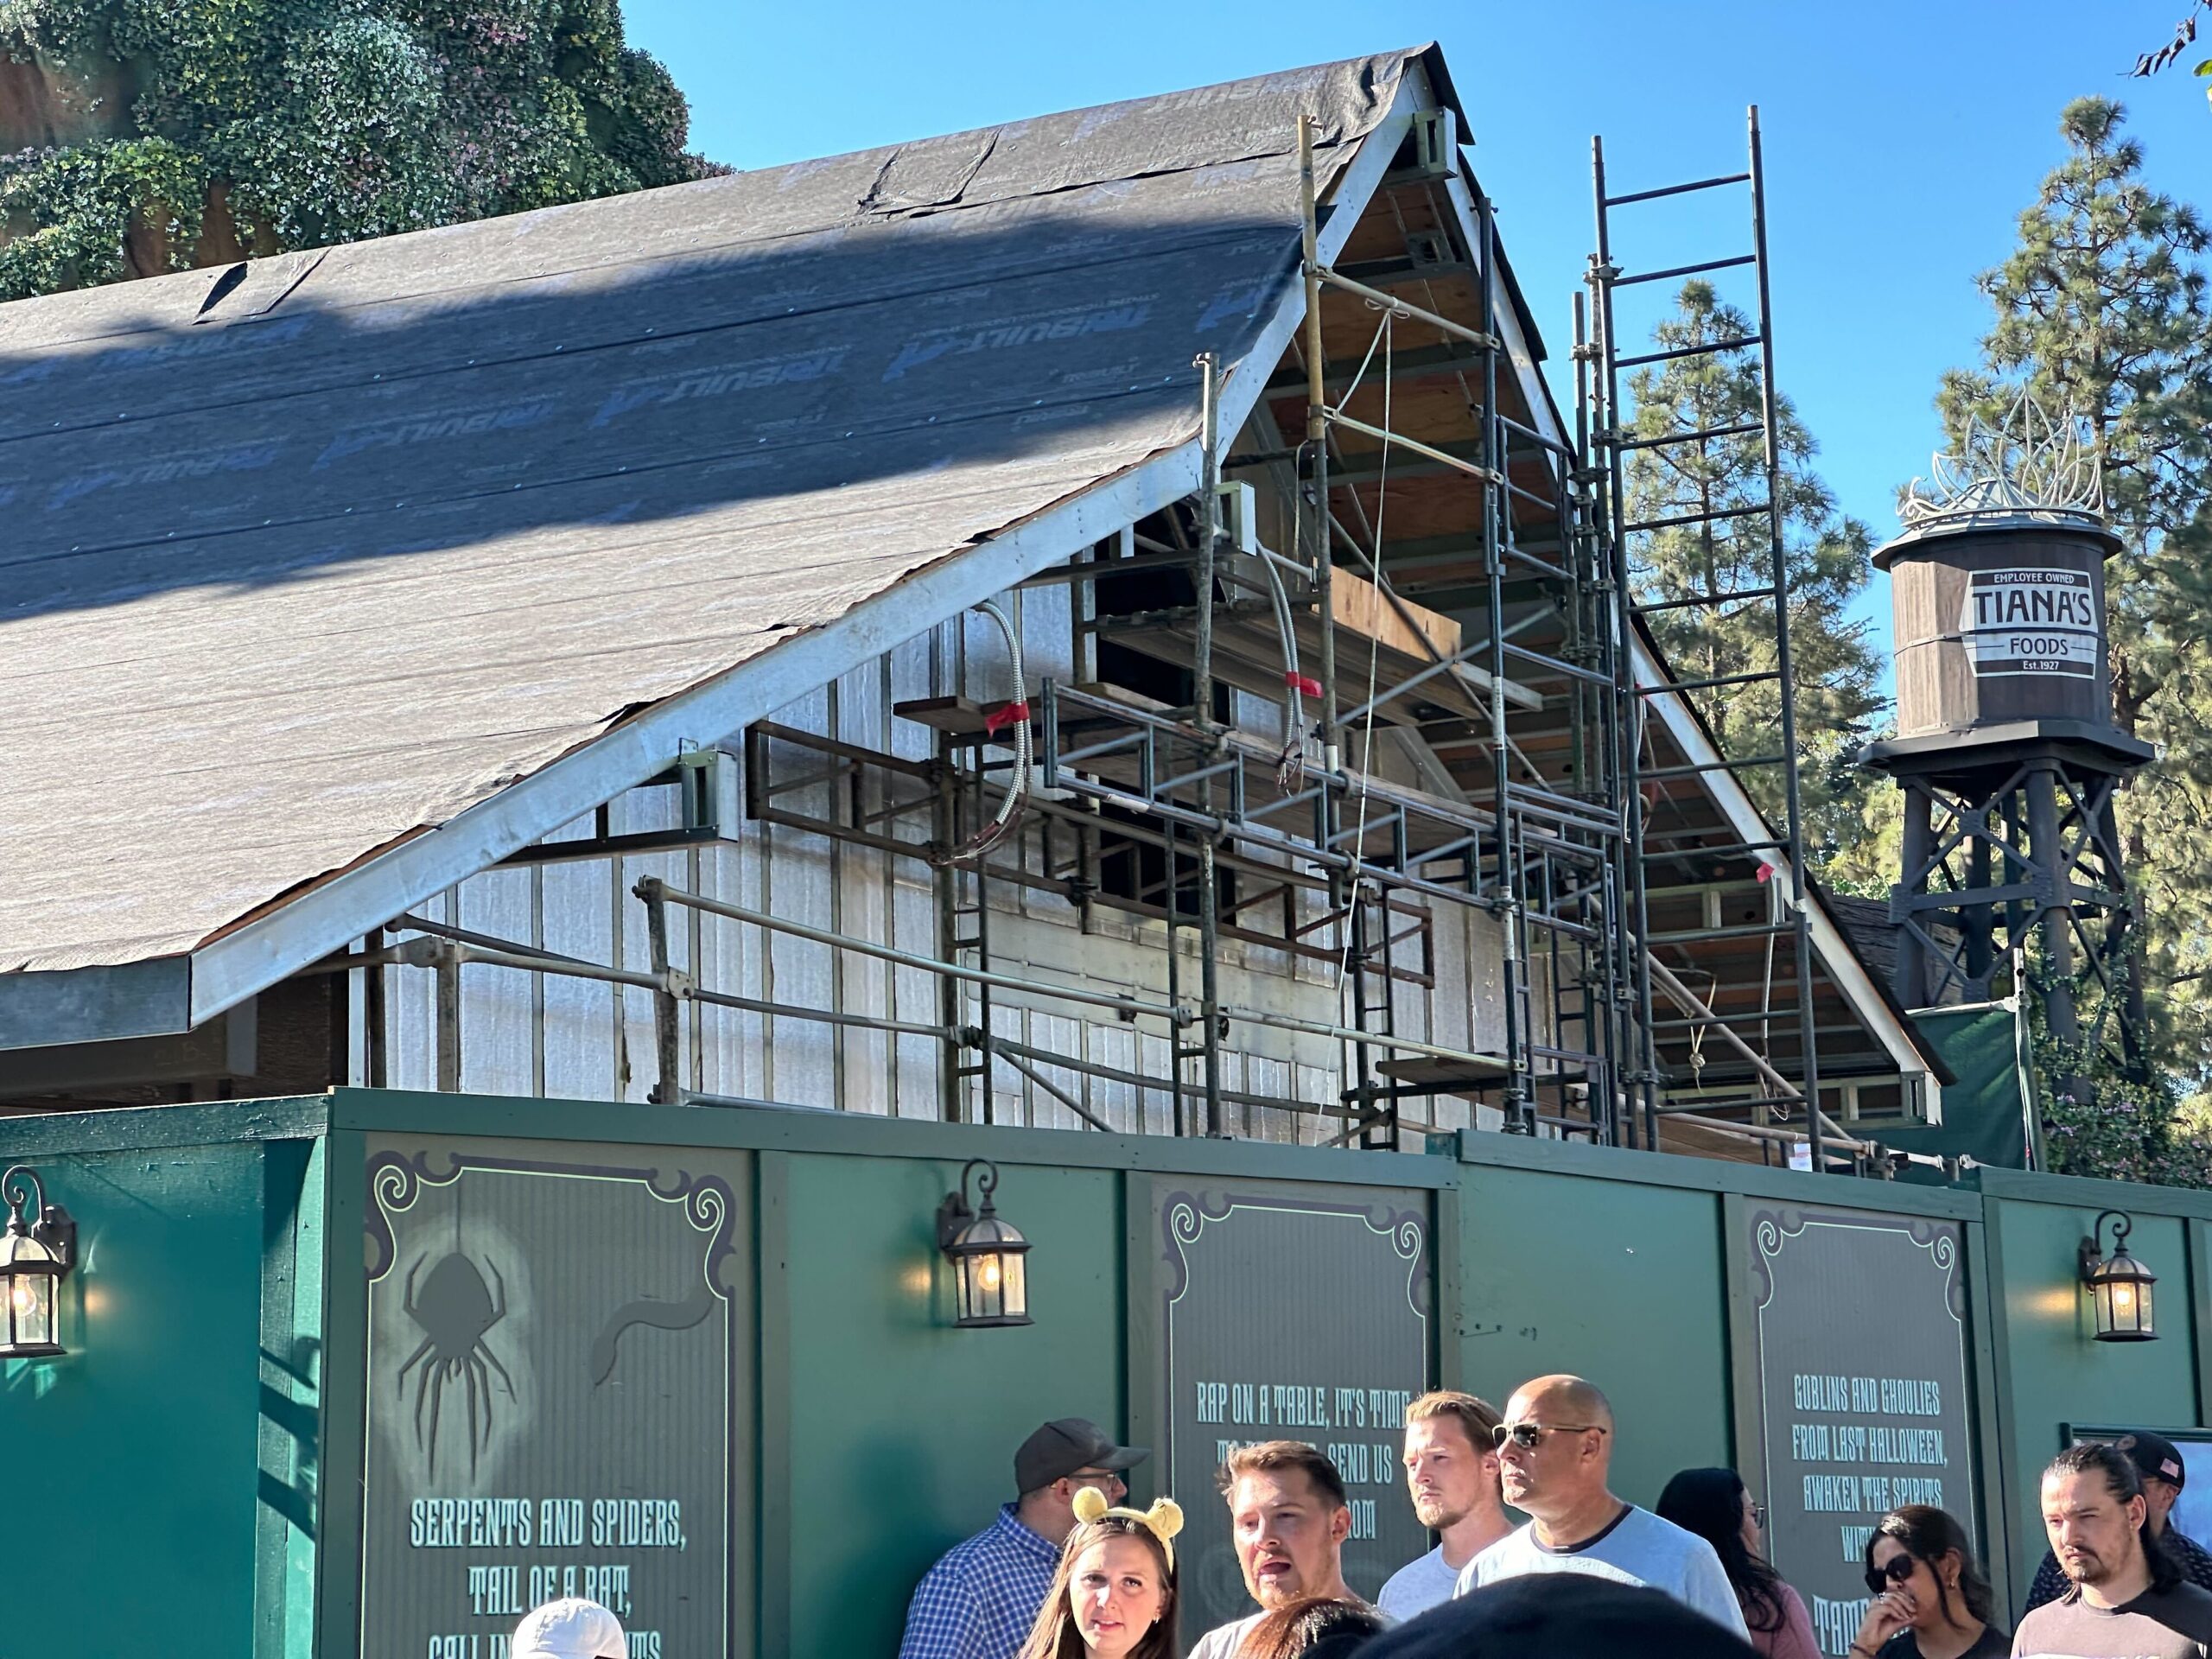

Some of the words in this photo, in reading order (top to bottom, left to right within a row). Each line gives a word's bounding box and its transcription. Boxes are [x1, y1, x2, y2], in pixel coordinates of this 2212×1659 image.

[1993, 572, 2044, 584] EMPLOYEE
[2045, 573, 2075, 584] OWNED
[1972, 589, 2092, 626] TIANA'S
[2010, 638, 2069, 655] FOODS
[1196, 1382, 1228, 1423] RAP
[1232, 1383, 1253, 1425] ON
[1259, 1384, 1269, 1425] A
[1273, 1385, 1330, 1430] TABLE,
[1334, 1388, 1364, 1427] IT'S
[1793, 1374, 1847, 1412] GOBLINS
[1852, 1376, 1877, 1414] AND
[1880, 1378, 1940, 1416] GHOULIES
[1373, 1445, 1393, 1484] US
[1791, 1424, 1829, 1461] FROM
[1832, 1426, 1864, 1463] LAST
[1869, 1427, 1948, 1467] HALLOWEEN,
[1803, 1475, 1859, 1511] AWAKEN
[1862, 1477, 1890, 1512] THE
[1892, 1478, 1942, 1510] SPIRITS
[410, 1498, 531, 1547] SERPENTS
[538, 1498, 584, 1546] AND
[591, 1498, 687, 1551] SPIDERS,
[1840, 1526, 1876, 1562] WIT
[467, 1566, 523, 1614] TAIL
[529, 1565, 558, 1611] OF
[563, 1566, 576, 1599] A
[583, 1566, 632, 1618] RAT,
